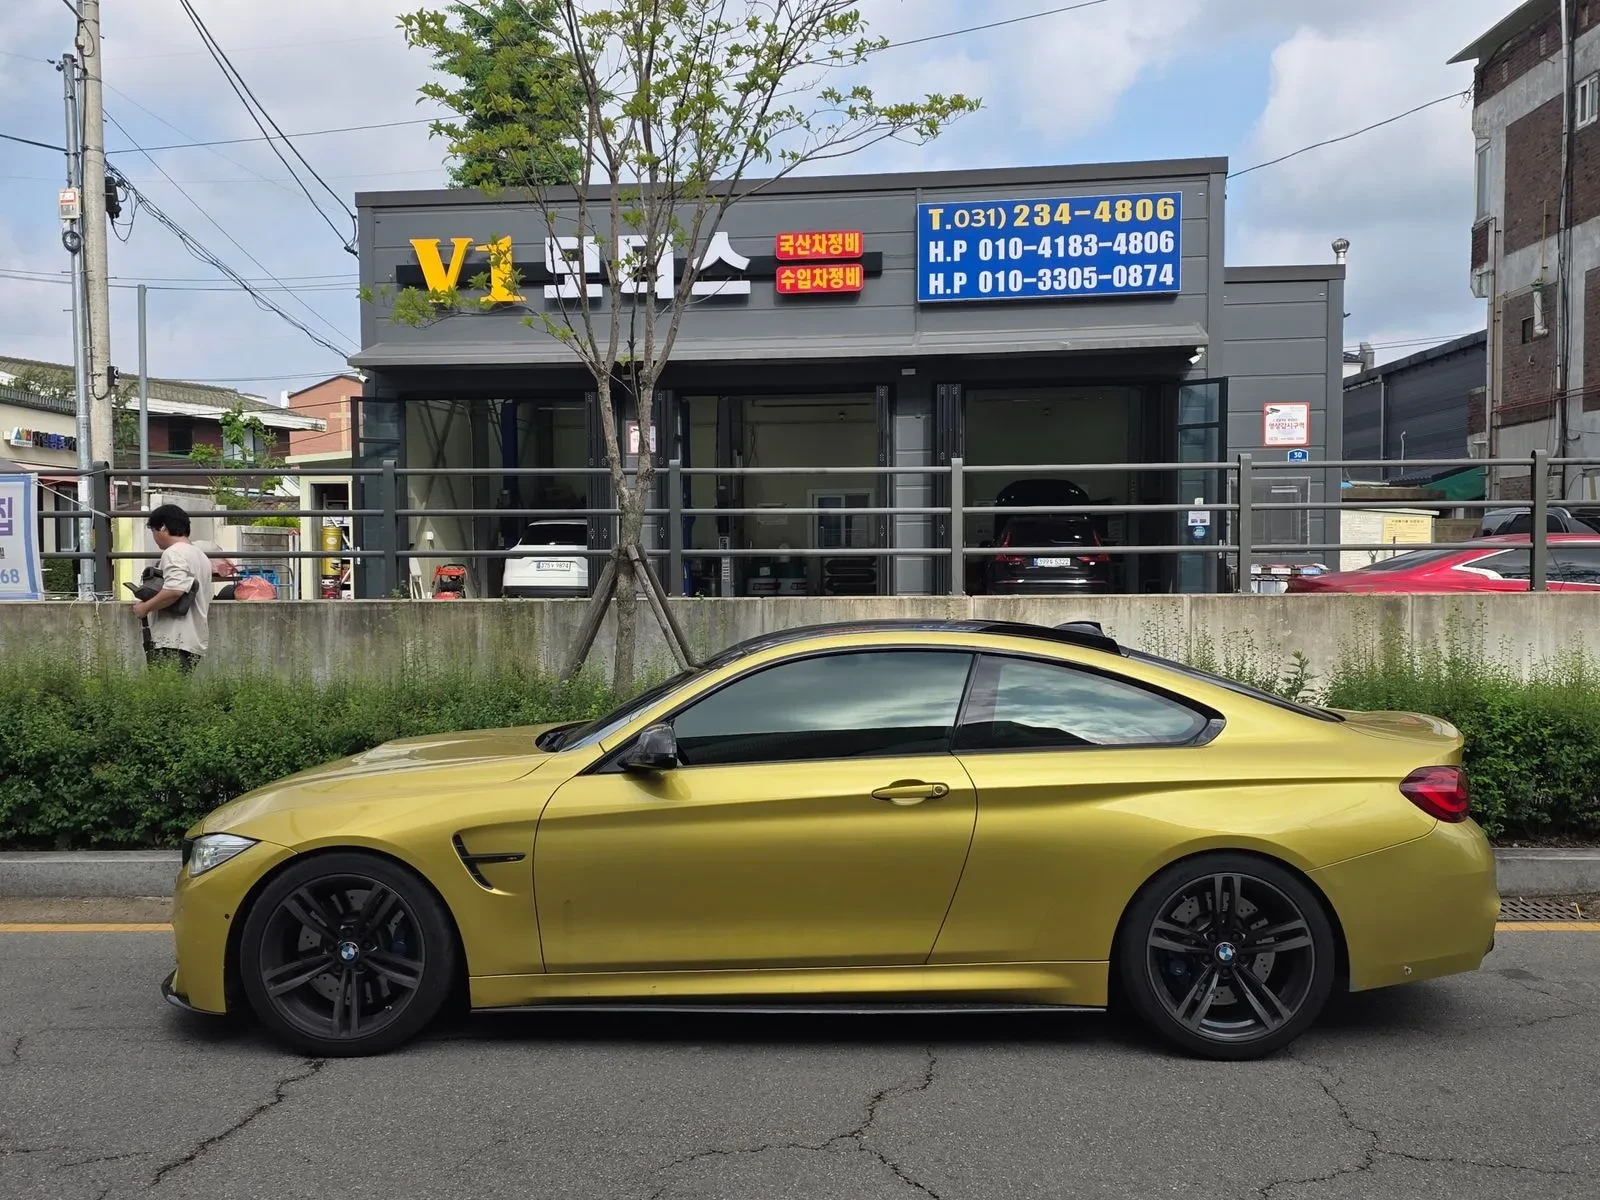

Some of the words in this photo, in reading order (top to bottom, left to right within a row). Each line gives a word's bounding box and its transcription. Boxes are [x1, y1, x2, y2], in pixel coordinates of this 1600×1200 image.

[928, 207, 1007, 230] T.031)
[1013, 198, 1175, 227] 234-4806
[779, 232, 861, 256] 국산차정비
[929, 239, 967, 263] H.P
[978, 230, 1175, 261] 010-4183-4806
[409, 235, 527, 302] V1
[544, 231, 751, 299] 모터스
[780, 266, 861, 290] 수입차정비
[929, 272, 967, 294] H.P
[978, 263, 1174, 293] 010-3305-0874
[0, 568, 20, 584] 68
